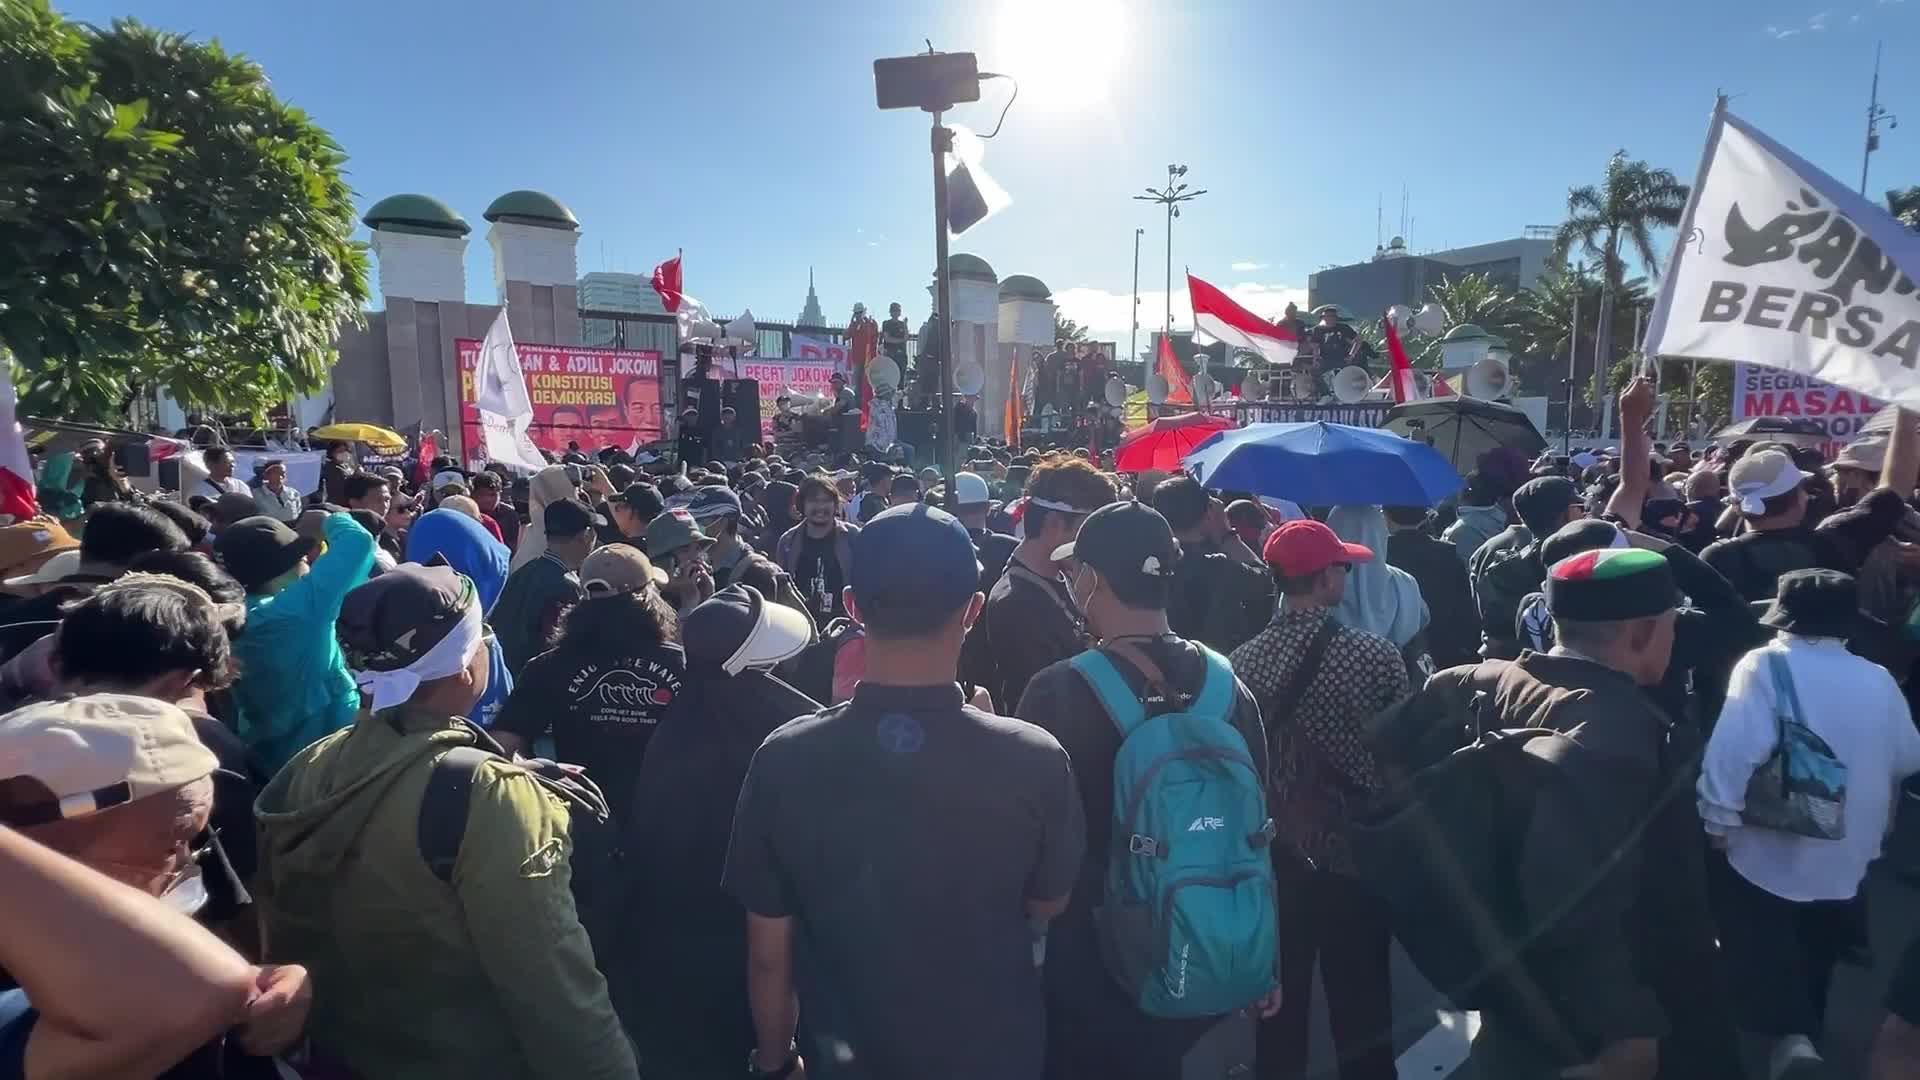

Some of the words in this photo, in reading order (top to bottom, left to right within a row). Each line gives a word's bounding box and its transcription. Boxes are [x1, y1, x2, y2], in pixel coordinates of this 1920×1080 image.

[549, 354, 560, 371] &
[567, 357, 603, 373] ADILI
[609, 358, 657, 375] JOKOWI
[532, 374, 613, 390] KONSTITUSI
[746, 366, 785, 381] PECAT
[792, 367, 833, 382] JOKOW
[533, 389, 616, 406] DEMOKRASI
